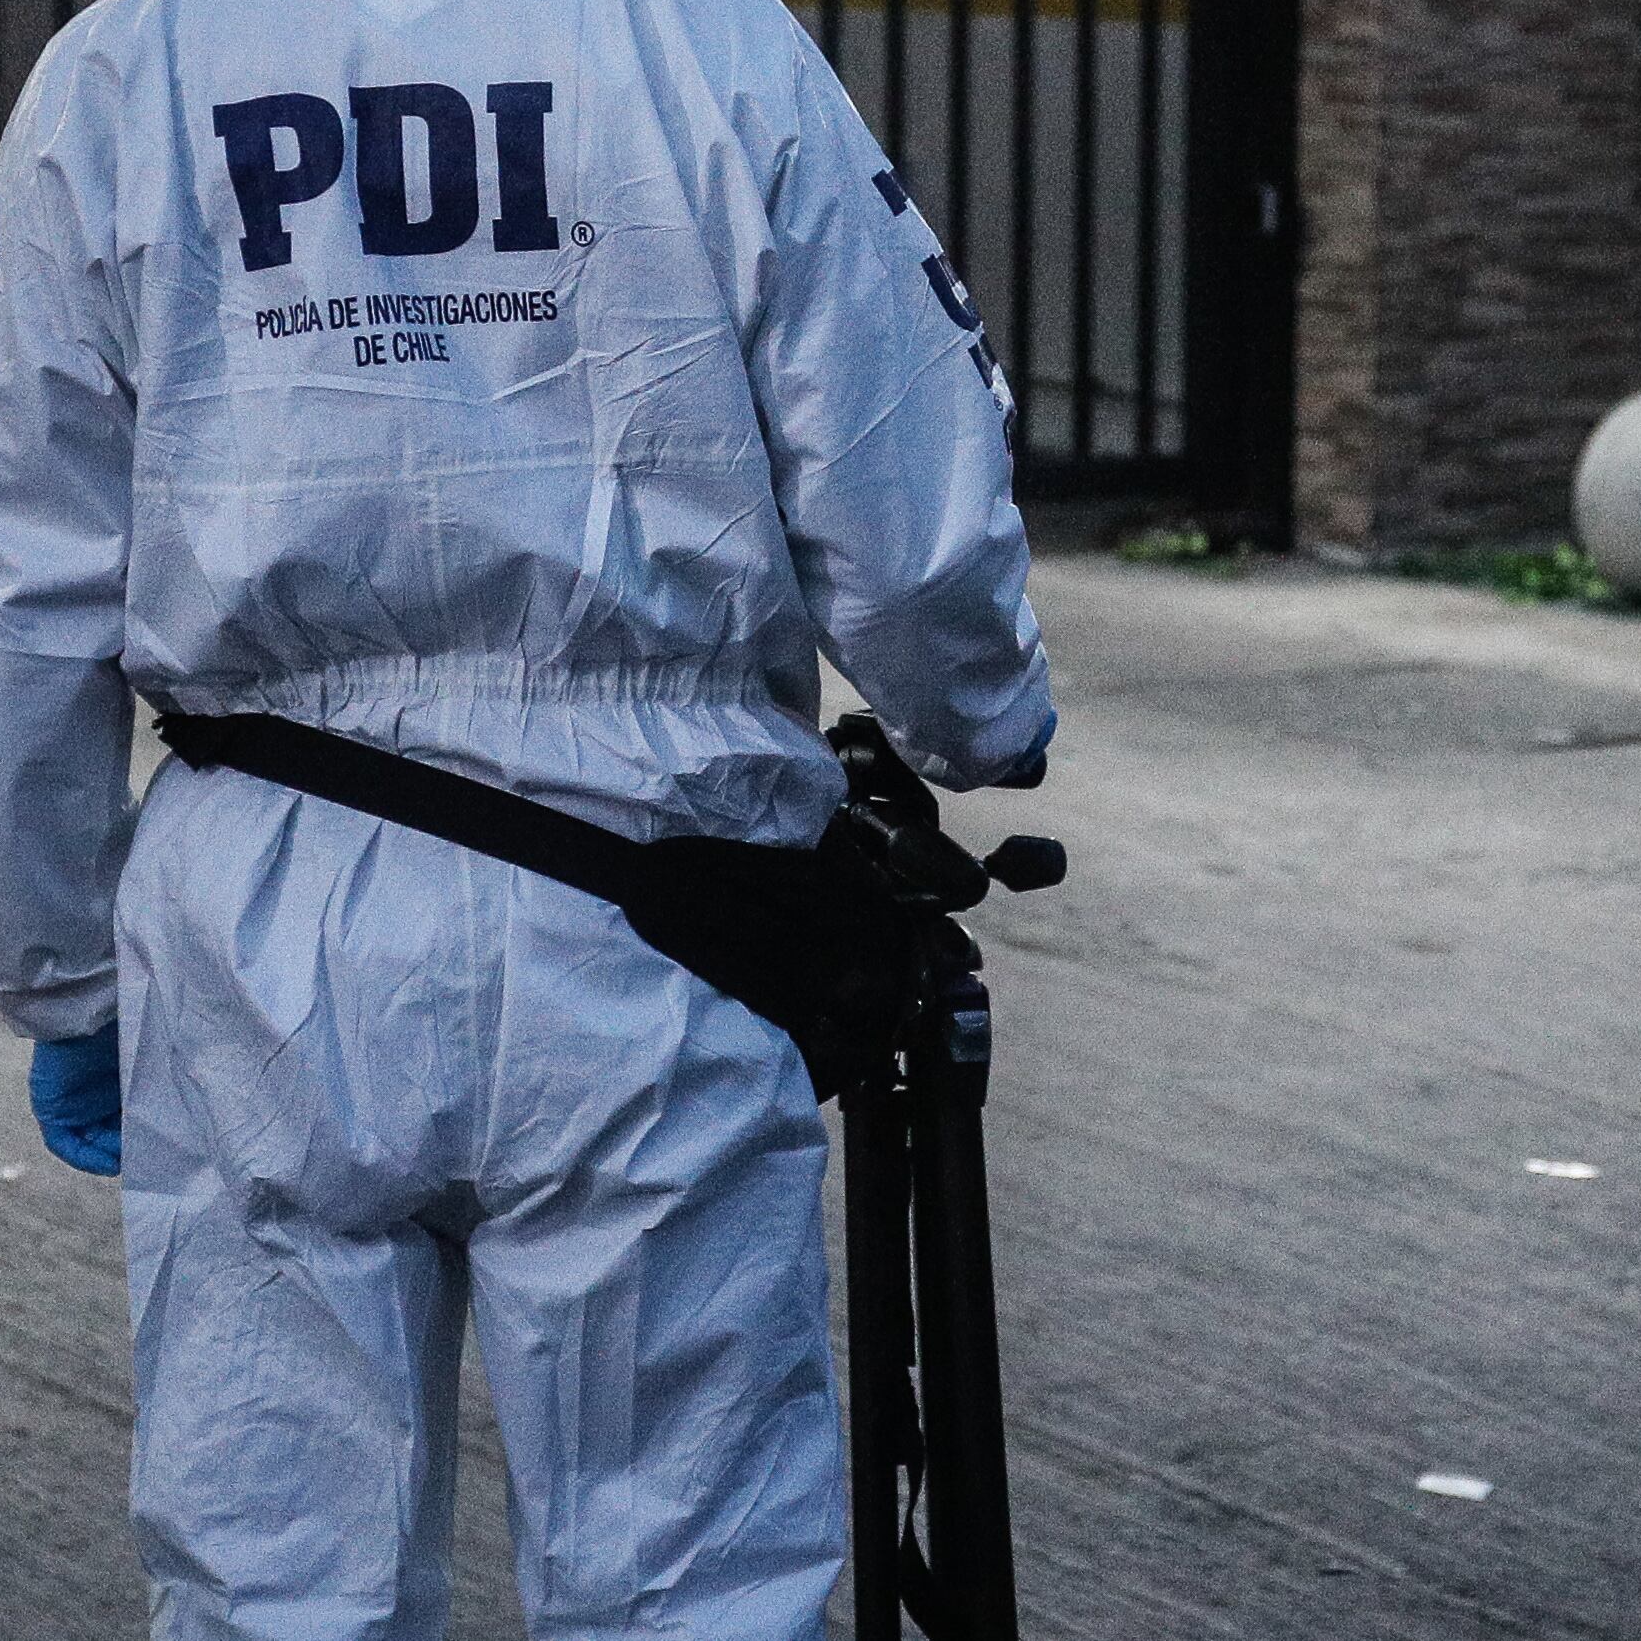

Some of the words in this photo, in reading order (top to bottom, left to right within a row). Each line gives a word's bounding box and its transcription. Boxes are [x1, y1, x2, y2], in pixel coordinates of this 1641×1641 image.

[212, 81, 560, 273] PDI
[255, 295, 324, 340] POLICÍA
[327, 296, 361, 329] DE
[366, 290, 558, 326] INVESTIGACIONES
[352, 333, 387, 367] DE
[391, 331, 451, 363] CHILE
